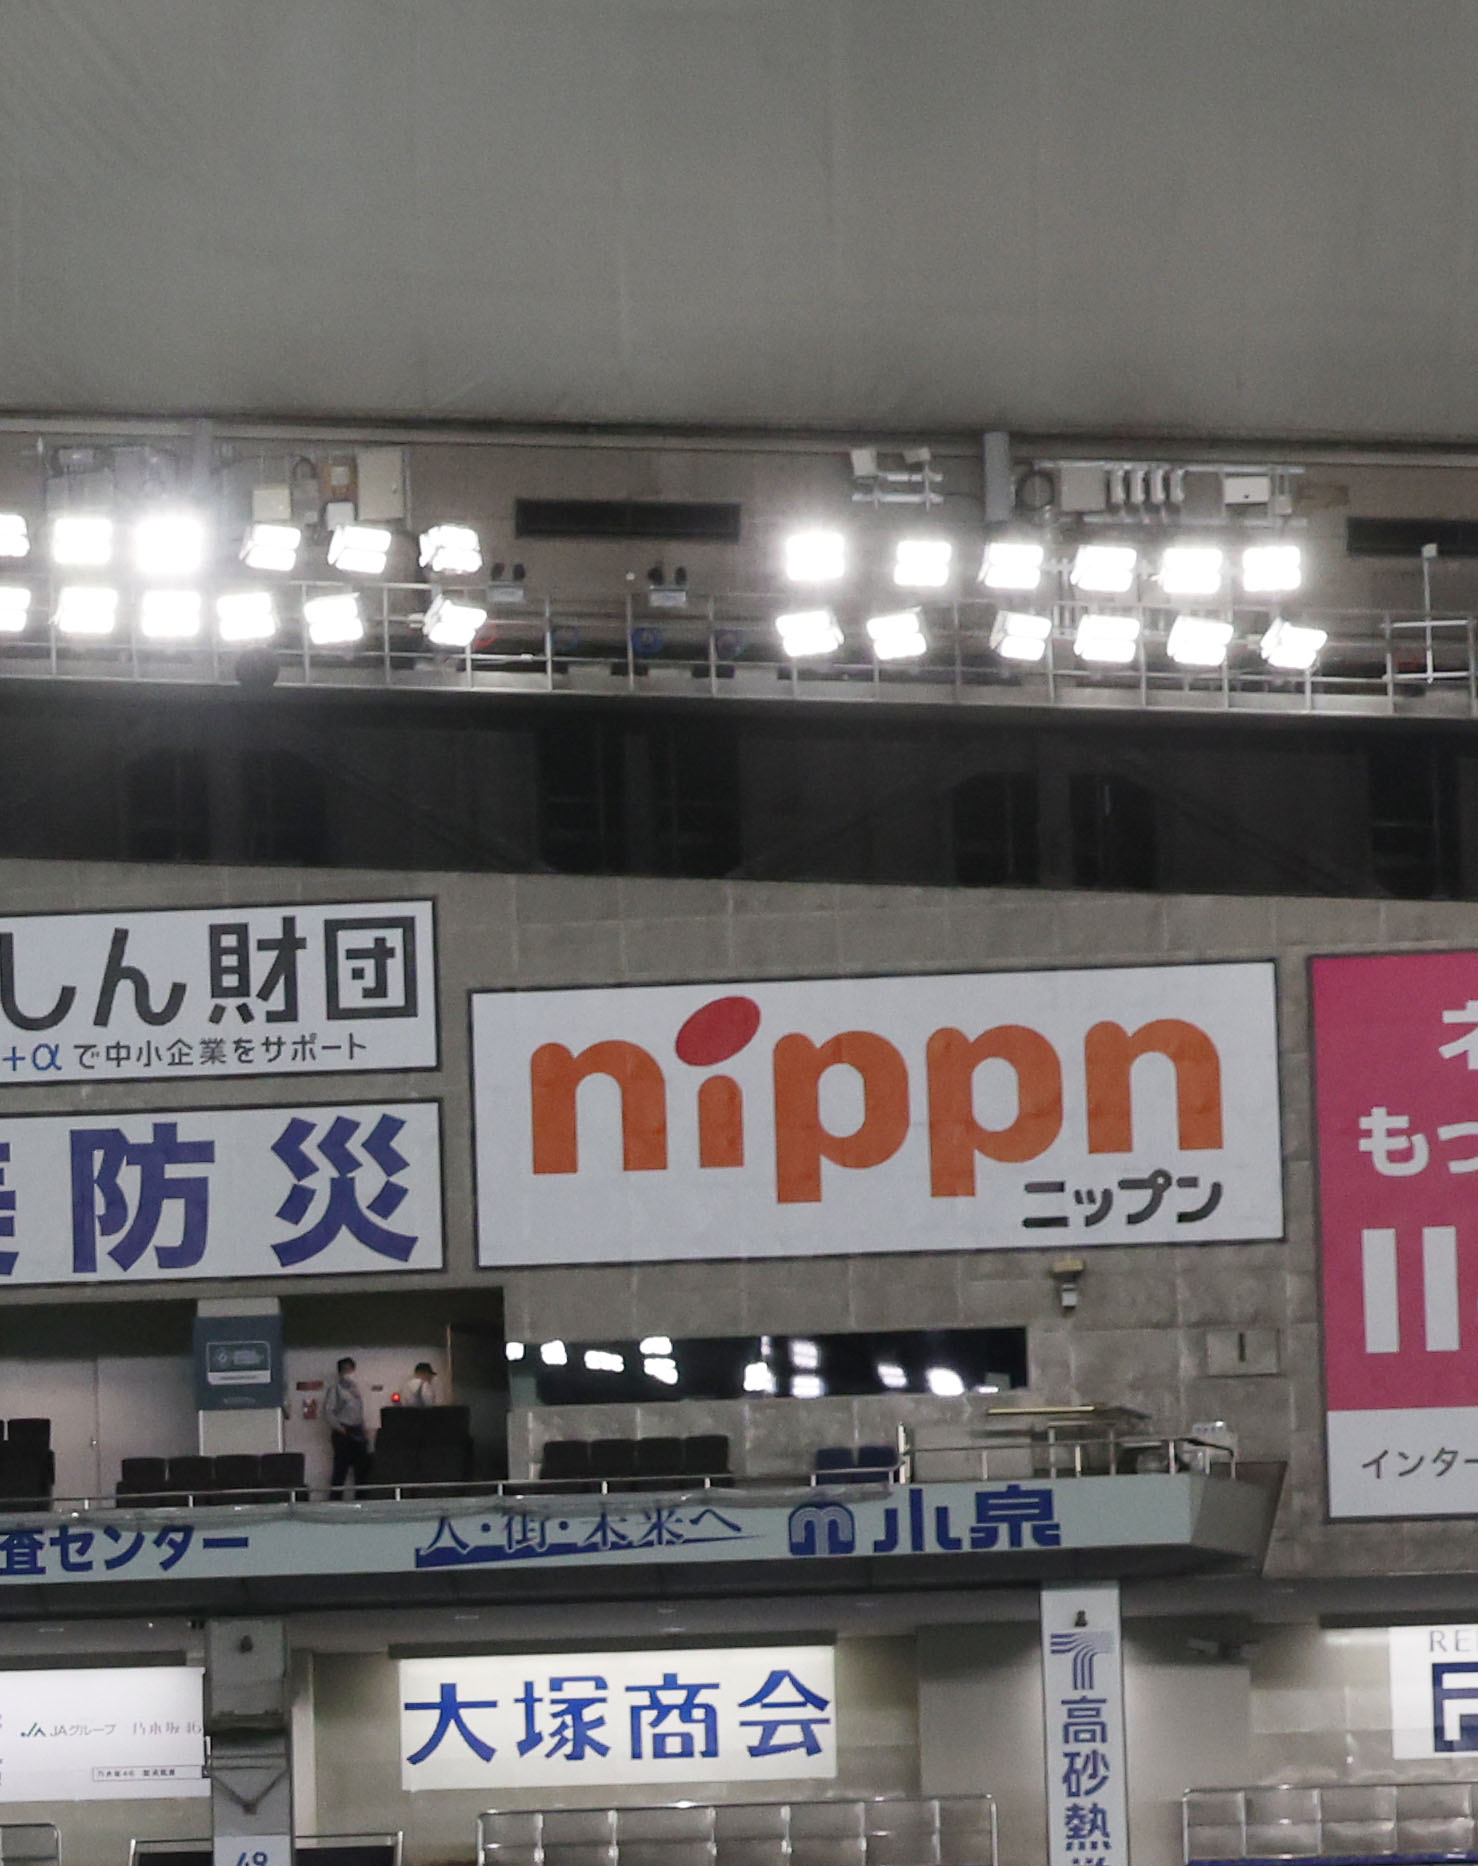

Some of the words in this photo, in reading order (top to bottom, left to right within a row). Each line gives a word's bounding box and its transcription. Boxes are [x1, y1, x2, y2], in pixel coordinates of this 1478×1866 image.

[530, 996, 1223, 1204] nippn
[1021, 1168, 1224, 1230] ニップン
[873, 1485, 1062, 1553] 小泉
[404, 1668, 832, 1766] 大塚商会
